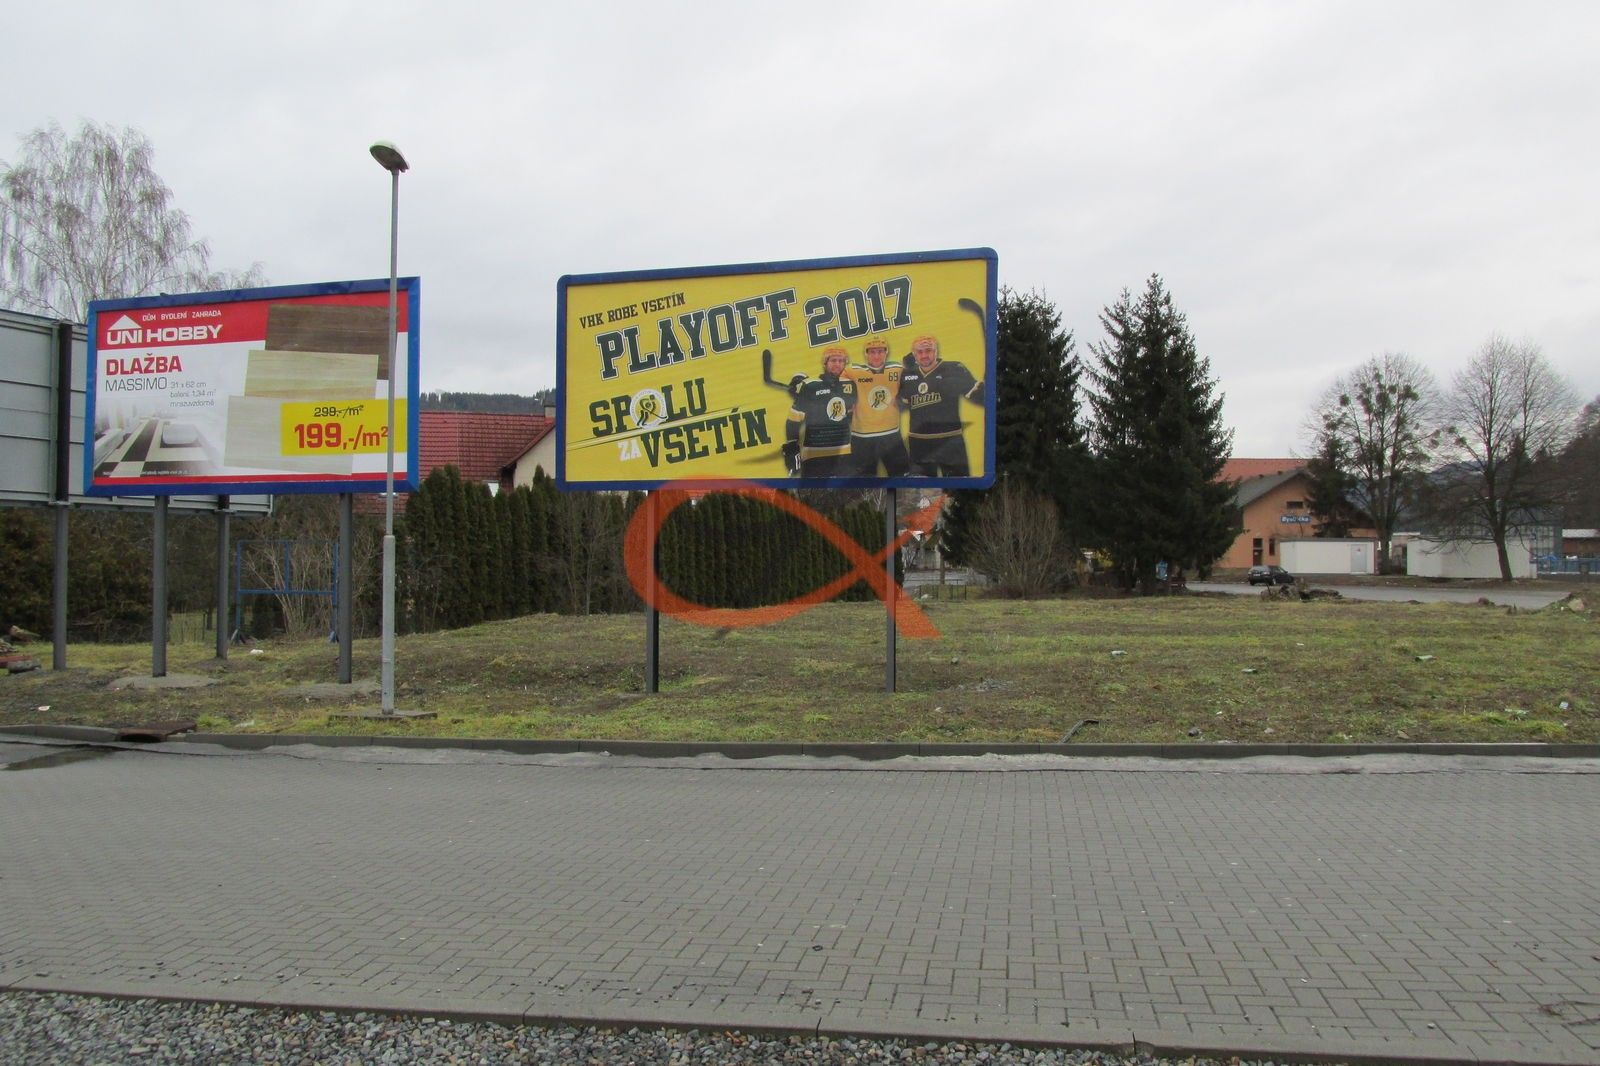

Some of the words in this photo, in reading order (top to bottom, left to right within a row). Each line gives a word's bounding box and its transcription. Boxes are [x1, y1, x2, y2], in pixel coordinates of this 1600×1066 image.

[142, 313, 157, 322] DŮM
[160, 311, 188, 321] BYDLENÍ
[192, 309, 222, 318] ZAHRADA
[579, 312, 605, 329] VHK
[607, 304, 639, 323] ROBE
[641, 291, 686, 314] VSETÍN
[106, 329, 143, 345] UNI
[146, 324, 223, 343] HOBBY
[595, 287, 798, 381] PLAYOFF
[803, 275, 913, 348] 2017
[106, 352, 183, 376] DLAŽBA
[105, 376, 168, 392] MASSIMO
[618, 439, 642, 461] ZA
[640, 407, 772, 468] VSETÍN
